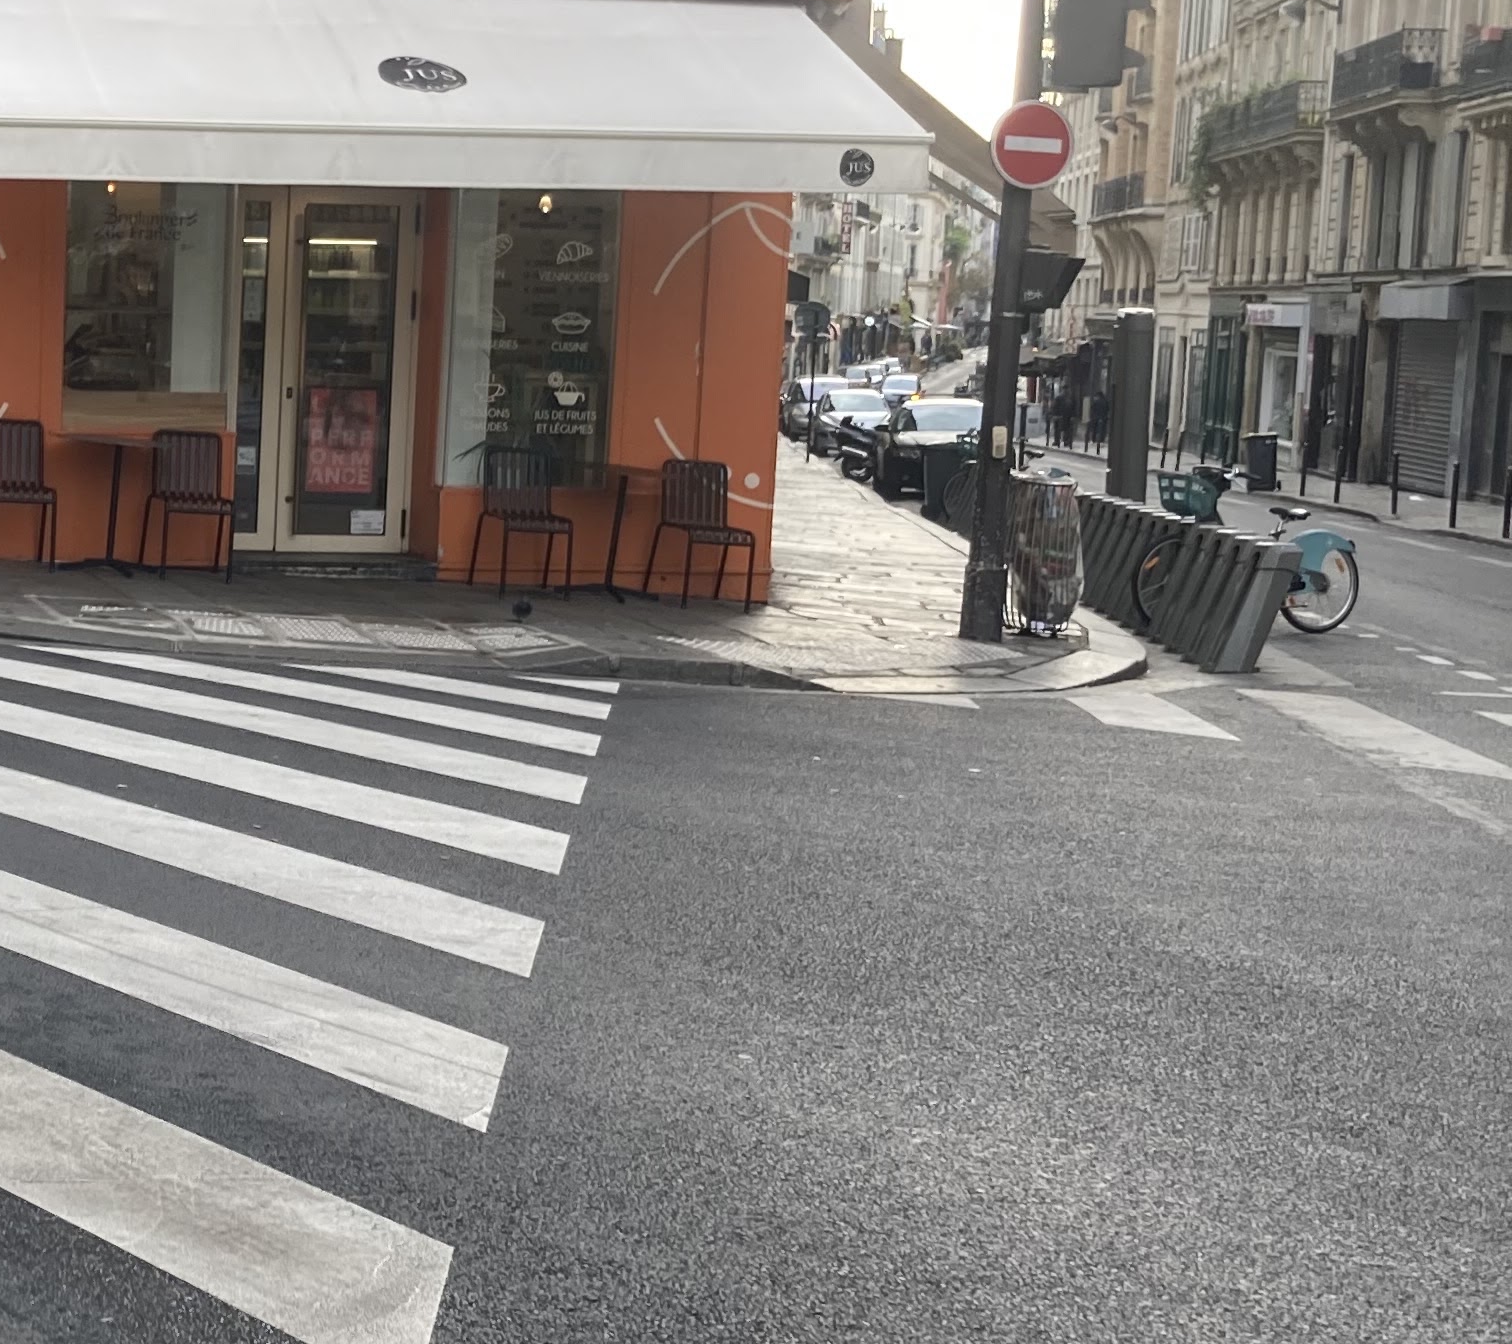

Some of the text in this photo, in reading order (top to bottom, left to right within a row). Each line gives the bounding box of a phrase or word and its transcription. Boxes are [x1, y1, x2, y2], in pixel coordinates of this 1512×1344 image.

[403, 68, 457, 82] JUS
[846, 161, 872, 176] JUS
[551, 341, 589, 353] CUISINE
[534, 410, 597, 422] JUS DE FRUITS
[536, 423, 594, 435] ET LÉGUMES
[309, 467, 370, 486] ANCE
